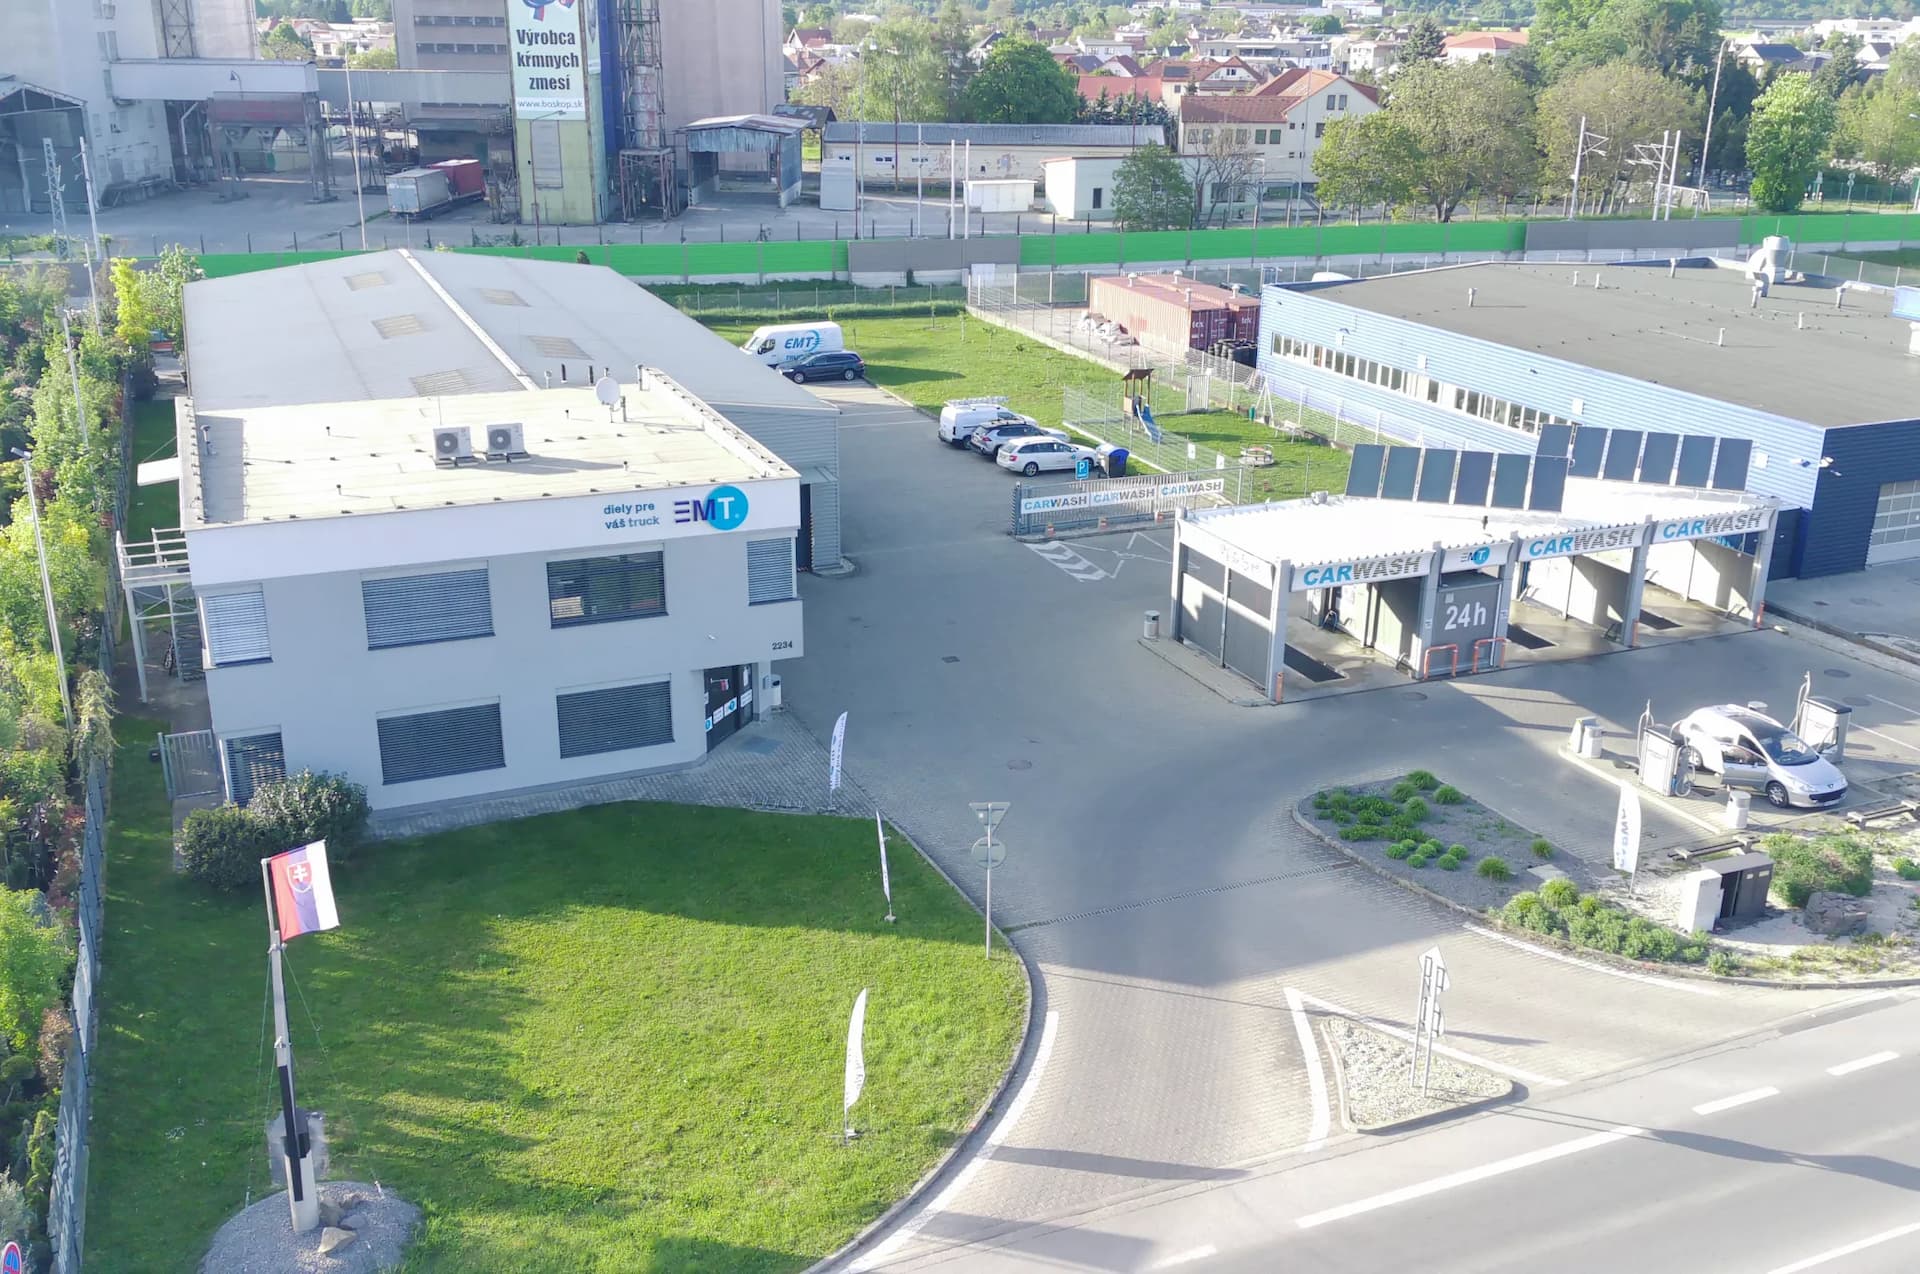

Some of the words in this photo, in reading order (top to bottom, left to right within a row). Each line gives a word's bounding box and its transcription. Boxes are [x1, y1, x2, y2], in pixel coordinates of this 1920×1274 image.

[516, 29, 576, 46] Výrobca
[516, 50, 579, 69] kŕmnych
[528, 74, 571, 90] zmesí
[784, 336, 814, 349] EMT
[1079, 462, 1085, 473] P
[1024, 496, 1087, 510] CARWASH
[1093, 488, 1155, 504] CARWASH
[1161, 481, 1222, 496] CARWASH
[603, 503, 632, 515] diely
[635, 503, 655, 514] pre
[605, 518, 626, 529] váš
[628, 515, 660, 528] truck
[1663, 511, 1763, 539] CARWASH
[1529, 528, 1635, 557] CARWASH
[1303, 555, 1422, 586] CARWASH
[772, 640, 793, 650] 2234
